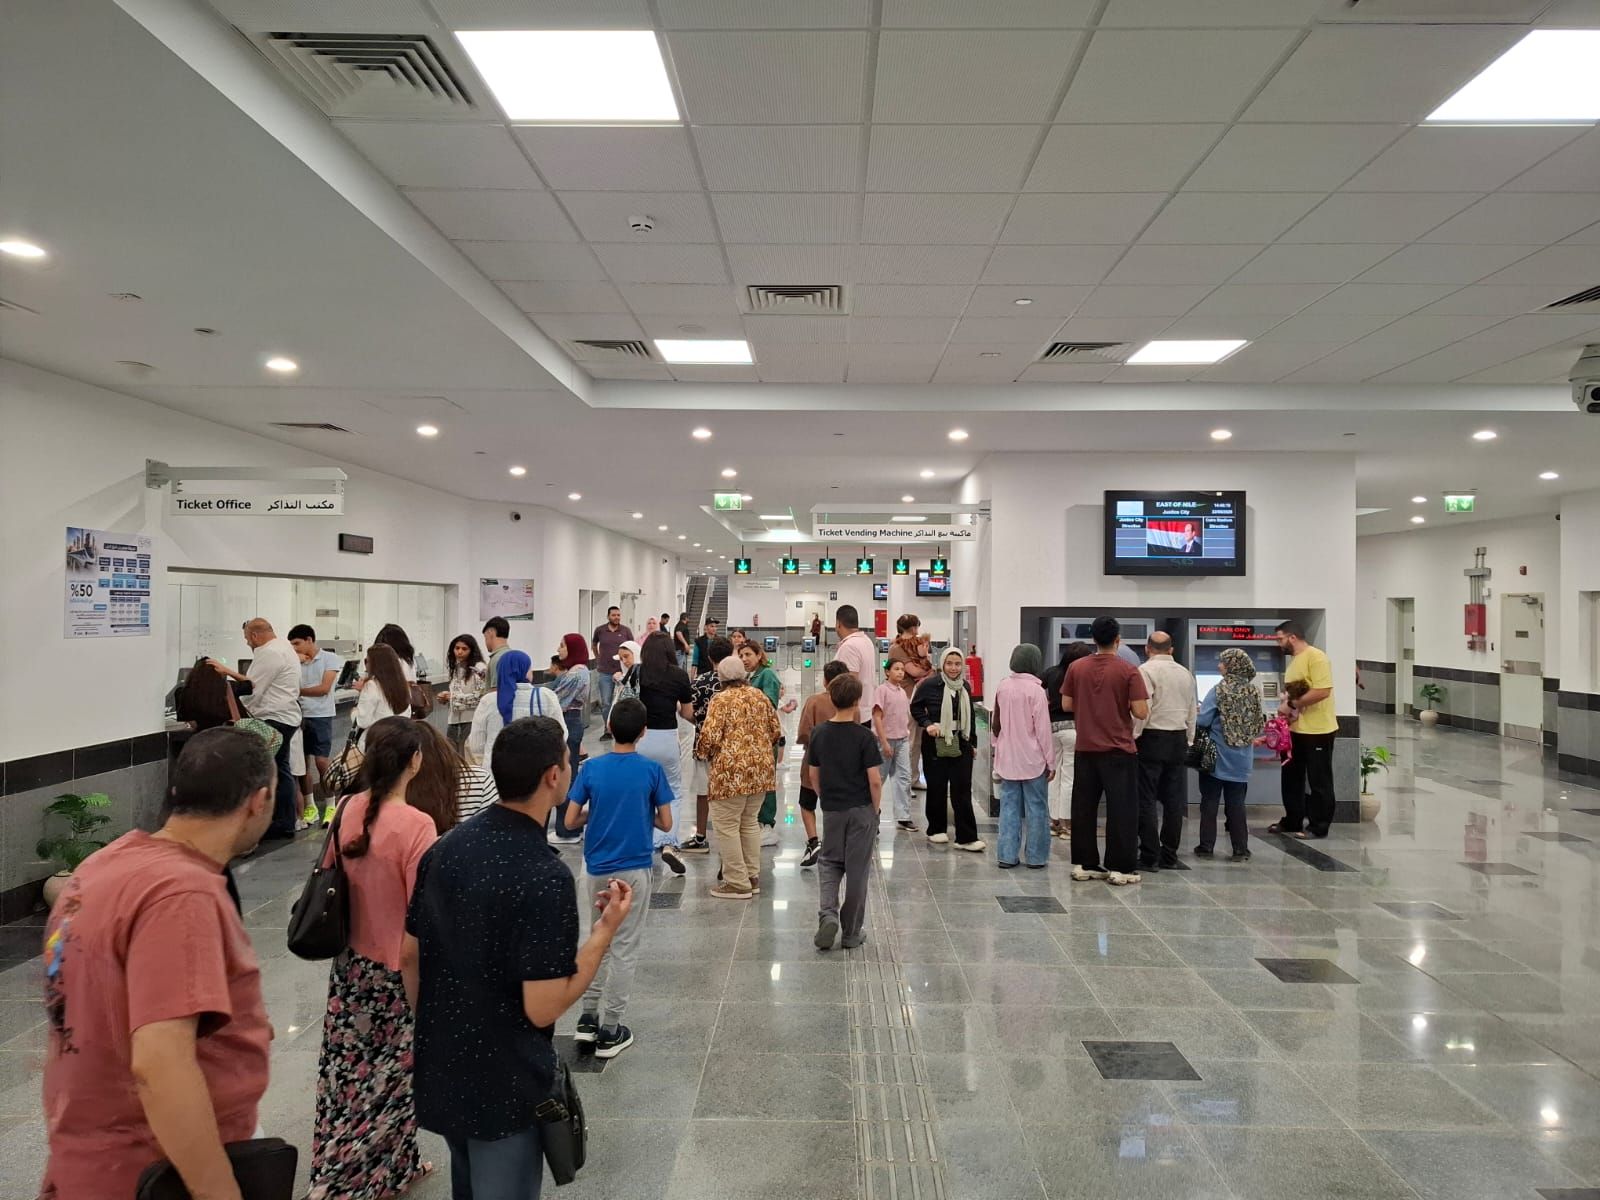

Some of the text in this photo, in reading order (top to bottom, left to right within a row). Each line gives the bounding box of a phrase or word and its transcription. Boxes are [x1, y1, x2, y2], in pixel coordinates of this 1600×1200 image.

[176, 499, 252, 510] Ticket Office
[267, 499, 335, 512] مكتب التذاكر
[818, 528, 913, 538] Ticket Vending Machine
[914, 528, 936, 538] التذاكر
[70, 584, 93, 597] %50
